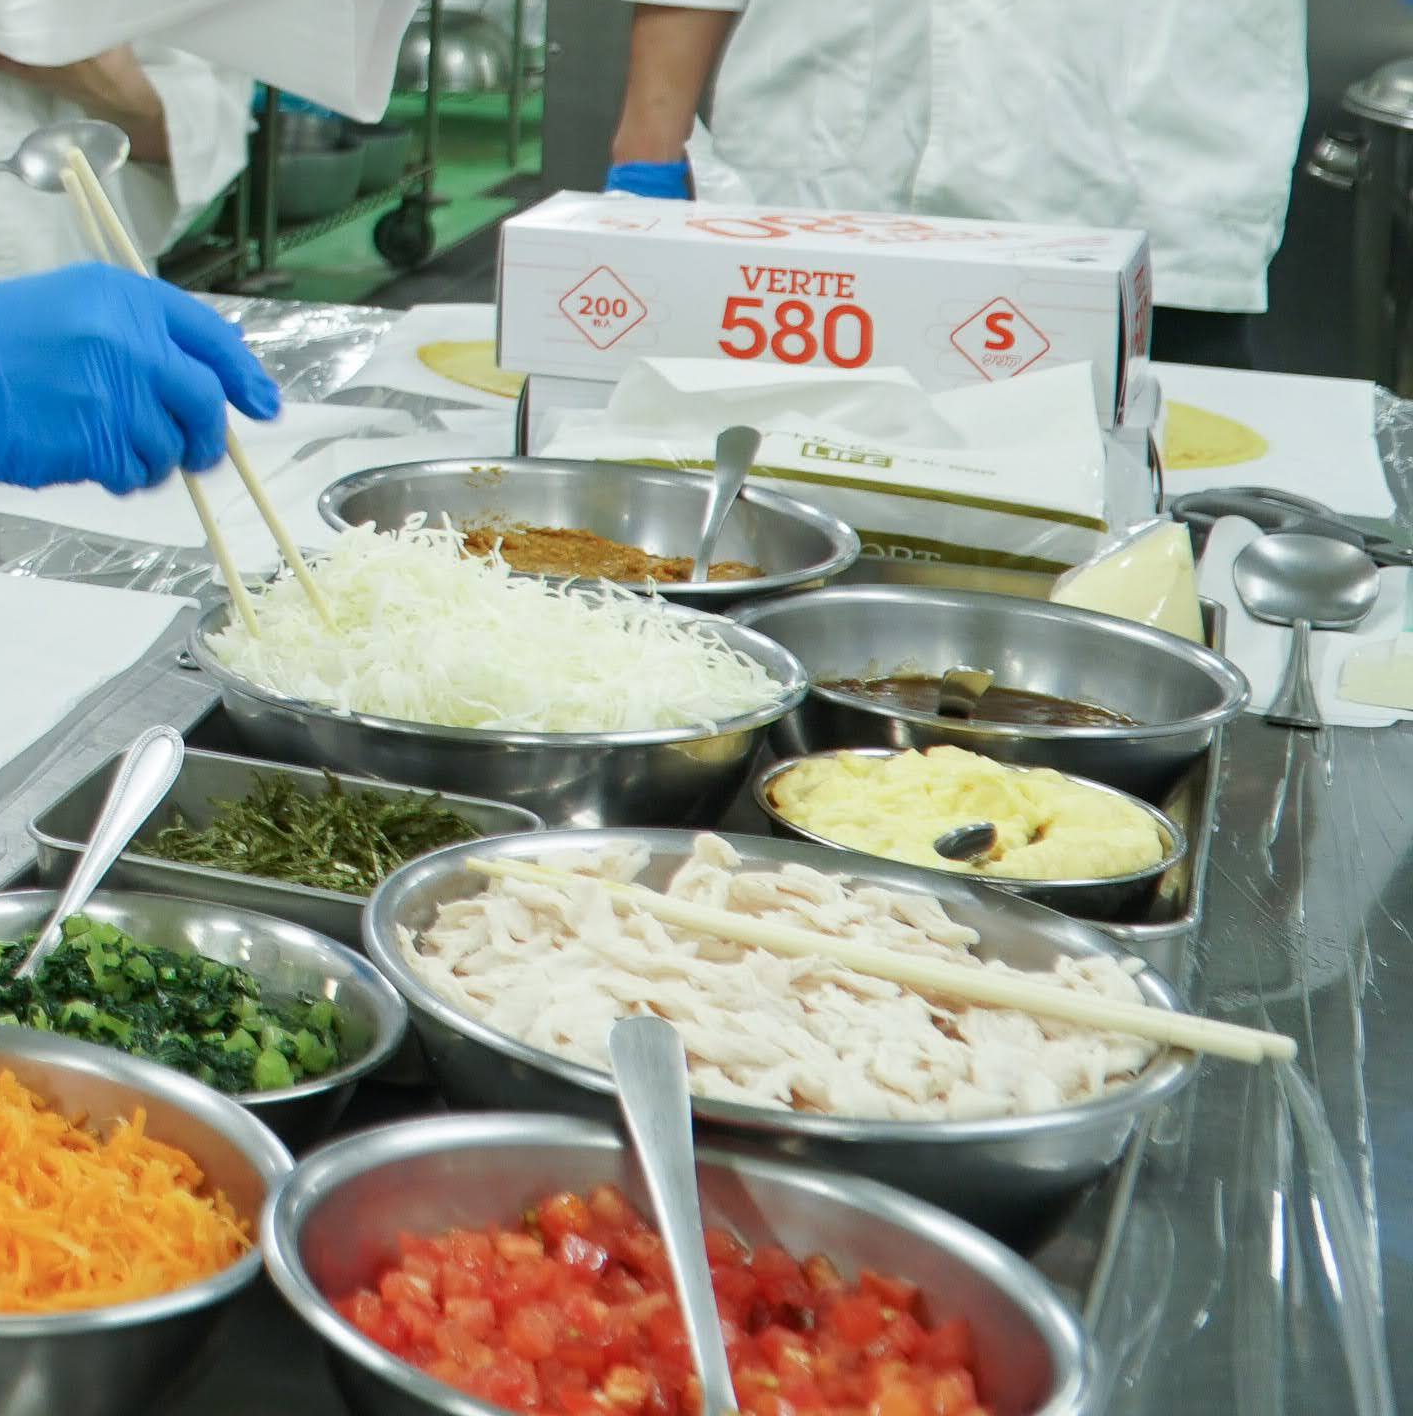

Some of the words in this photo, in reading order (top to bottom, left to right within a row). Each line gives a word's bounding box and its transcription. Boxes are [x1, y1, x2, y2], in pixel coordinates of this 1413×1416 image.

[740, 264, 855, 299] VERTE
[579, 295, 628, 318] 200
[718, 295, 874, 369] 580
[984, 312, 1015, 351] S
